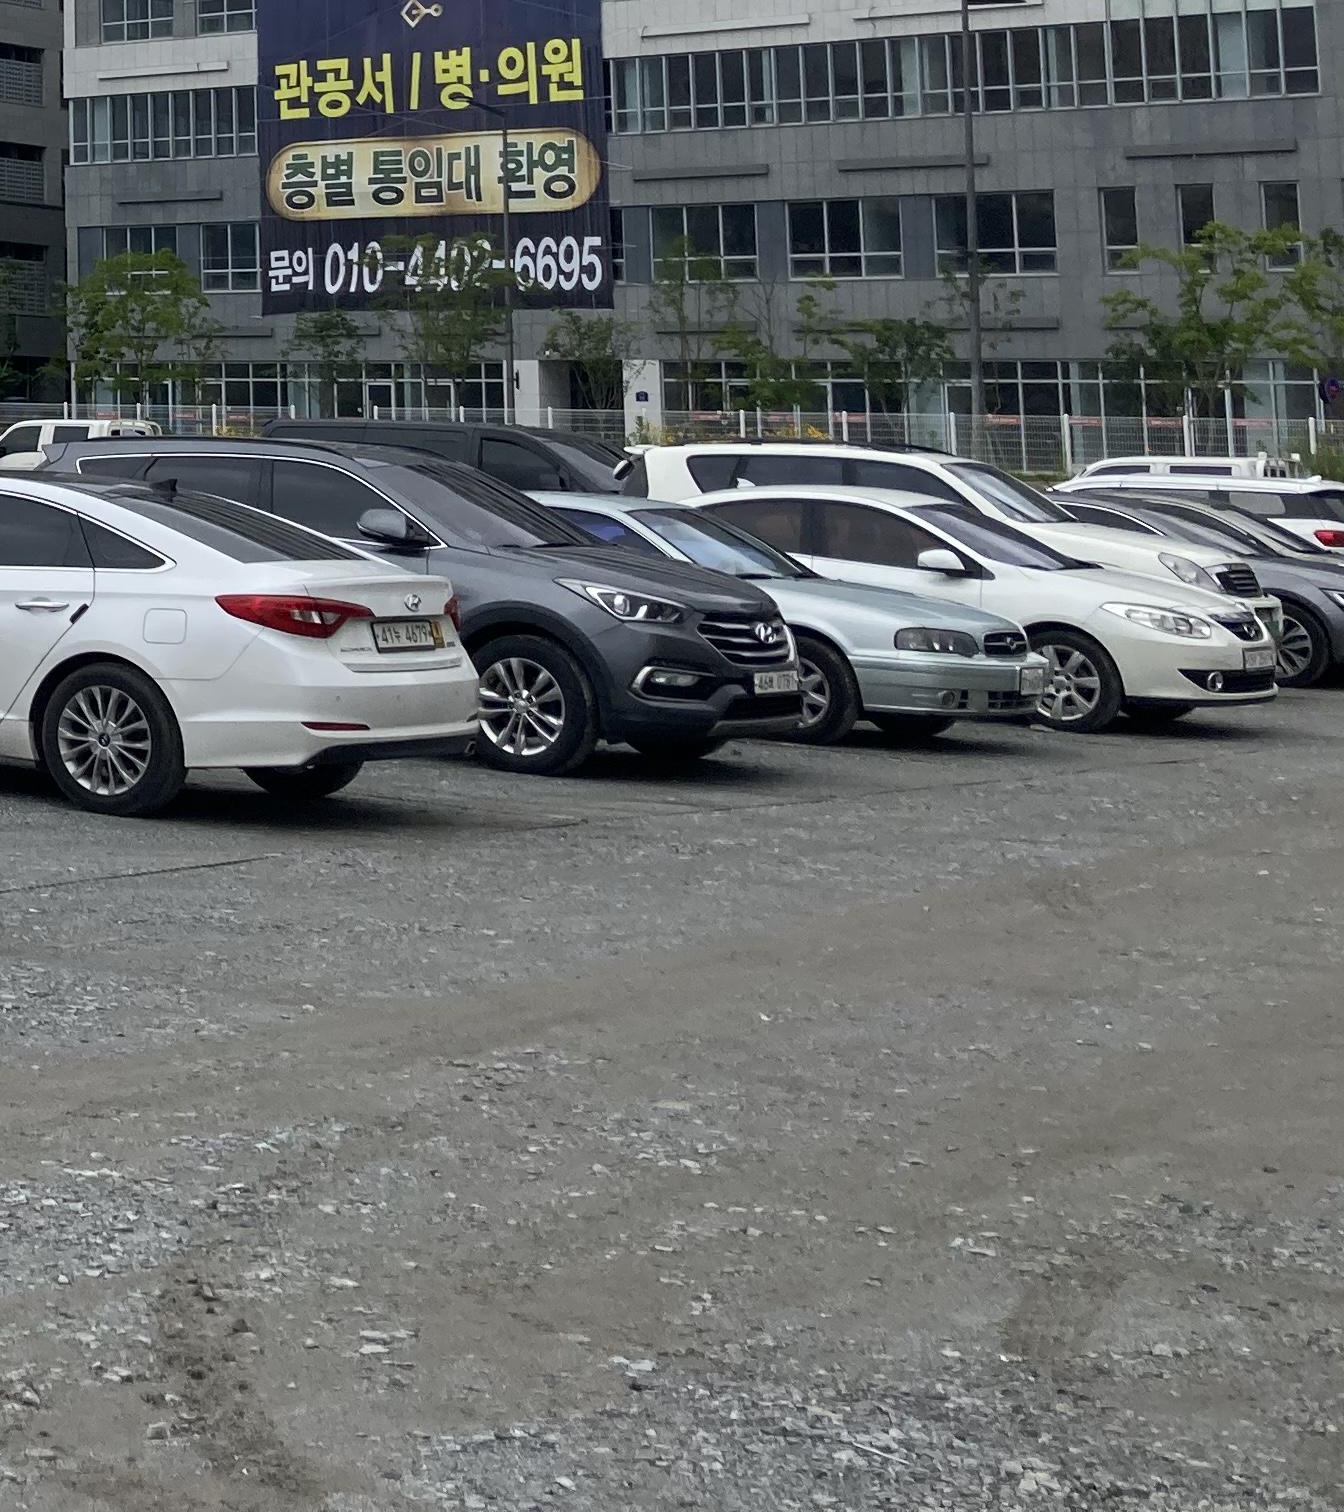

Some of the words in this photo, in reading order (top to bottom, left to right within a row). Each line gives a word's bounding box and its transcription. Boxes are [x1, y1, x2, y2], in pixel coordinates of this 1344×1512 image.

[274, 52, 394, 121] 관공서
[434, 39, 584, 110] 병·의원
[281, 151, 356, 211] 층별
[367, 144, 483, 206] 통임대
[497, 139, 577, 200] 환영
[268, 248, 315, 292] 문의
